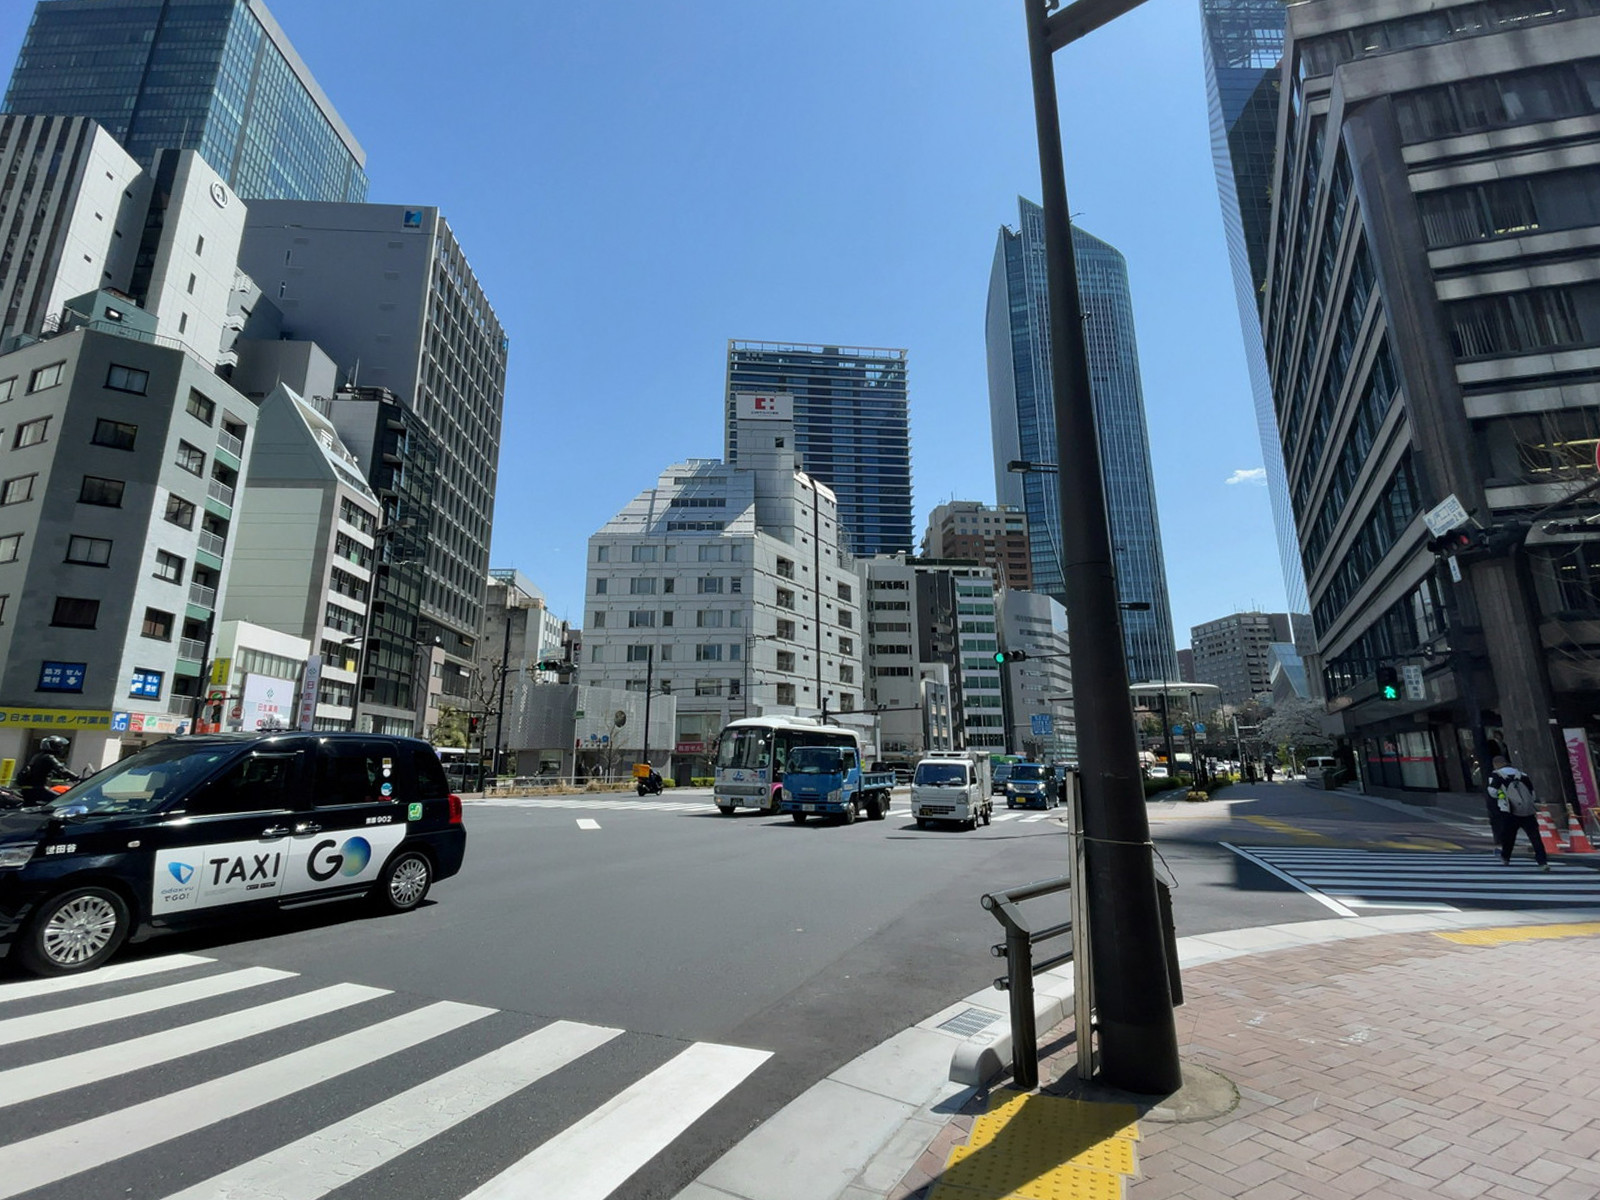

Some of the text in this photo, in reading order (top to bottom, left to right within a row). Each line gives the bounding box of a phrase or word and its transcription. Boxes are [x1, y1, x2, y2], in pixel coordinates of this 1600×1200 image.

[46, 843, 77, 855] 世田谷
[210, 852, 280, 886] TAXI
